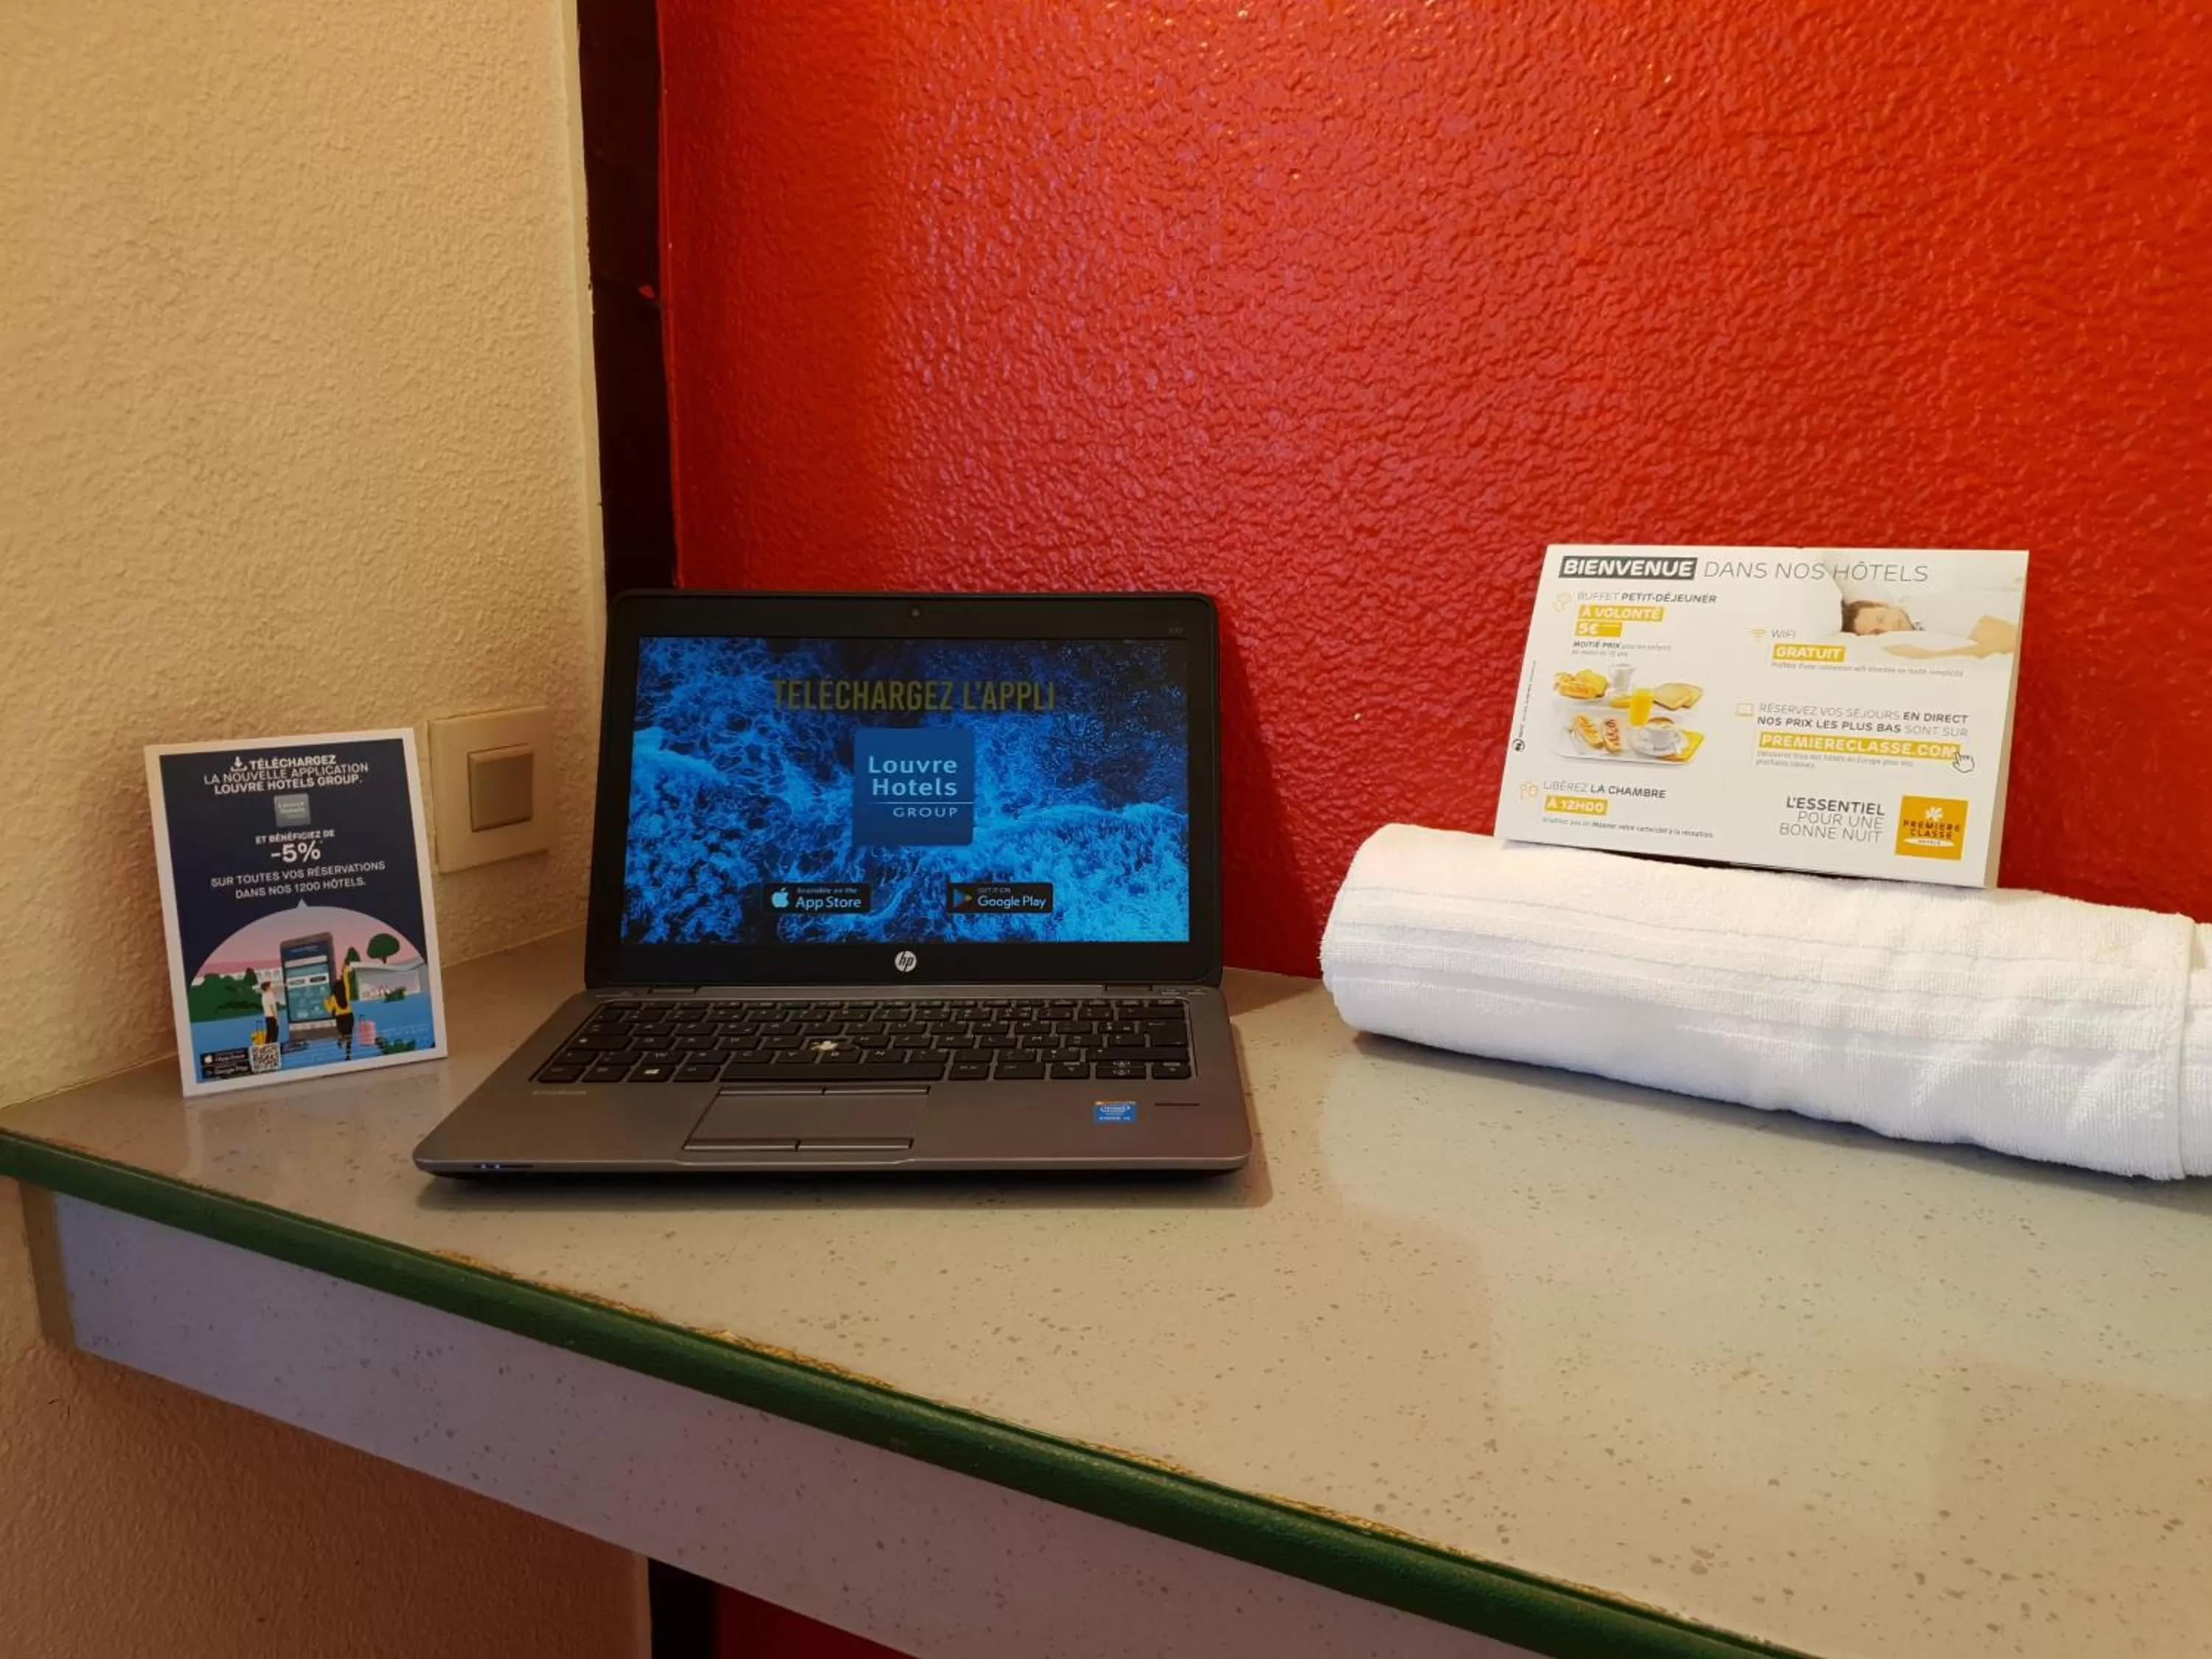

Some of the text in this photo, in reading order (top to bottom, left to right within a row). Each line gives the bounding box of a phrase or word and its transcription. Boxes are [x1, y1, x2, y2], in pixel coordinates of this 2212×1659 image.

[1562, 558, 1929, 582] BIENVENUE DANS NOS HÔTELS
[1577, 592, 1718, 603] BUFFET PETIT-DÉJEUNER
[1578, 622, 1599, 635] 5€
[1777, 646, 1843, 659] GRATUIT
[962, 680, 1054, 711] L'APPLI
[1759, 703, 1969, 723] RÉSERVEZ VOS SÉJOURS EN DIRECT
[1757, 717, 1969, 737] NOS PRIX LES PLUS BAS SONT SUR
[249, 755, 337, 771] TÉLÉCHARGEZ
[868, 755, 958, 773] Louvre
[204, 762, 369, 785] LA NOUVELLE APPLICATION
[215, 782, 265, 794] LOUVRE
[268, 778, 315, 791] HOTELS
[872, 778, 958, 796] Hotels
[1543, 780, 1667, 799] LIBÉREZ LA CHAMBRE
[893, 807, 959, 818] GROUP
[1787, 796, 1885, 815] L'ESSENTIEL
[1798, 811, 1885, 830] POUR UNE
[255, 829, 335, 844] ET BÉNÉFICIEZ DE
[1779, 822, 1884, 843] BONNE NUIT
[1910, 828, 1953, 839] CLASSE
[211, 860, 386, 887] SUR TOUTES VOS RÉSERVATIONS
[235, 887, 265, 899] DANS
[268, 884, 292, 896] NOS
[294, 881, 321, 893] 1200
[795, 895, 862, 911] App Store
[977, 894, 1047, 909] Google Play
[897, 950, 916, 972] hp
